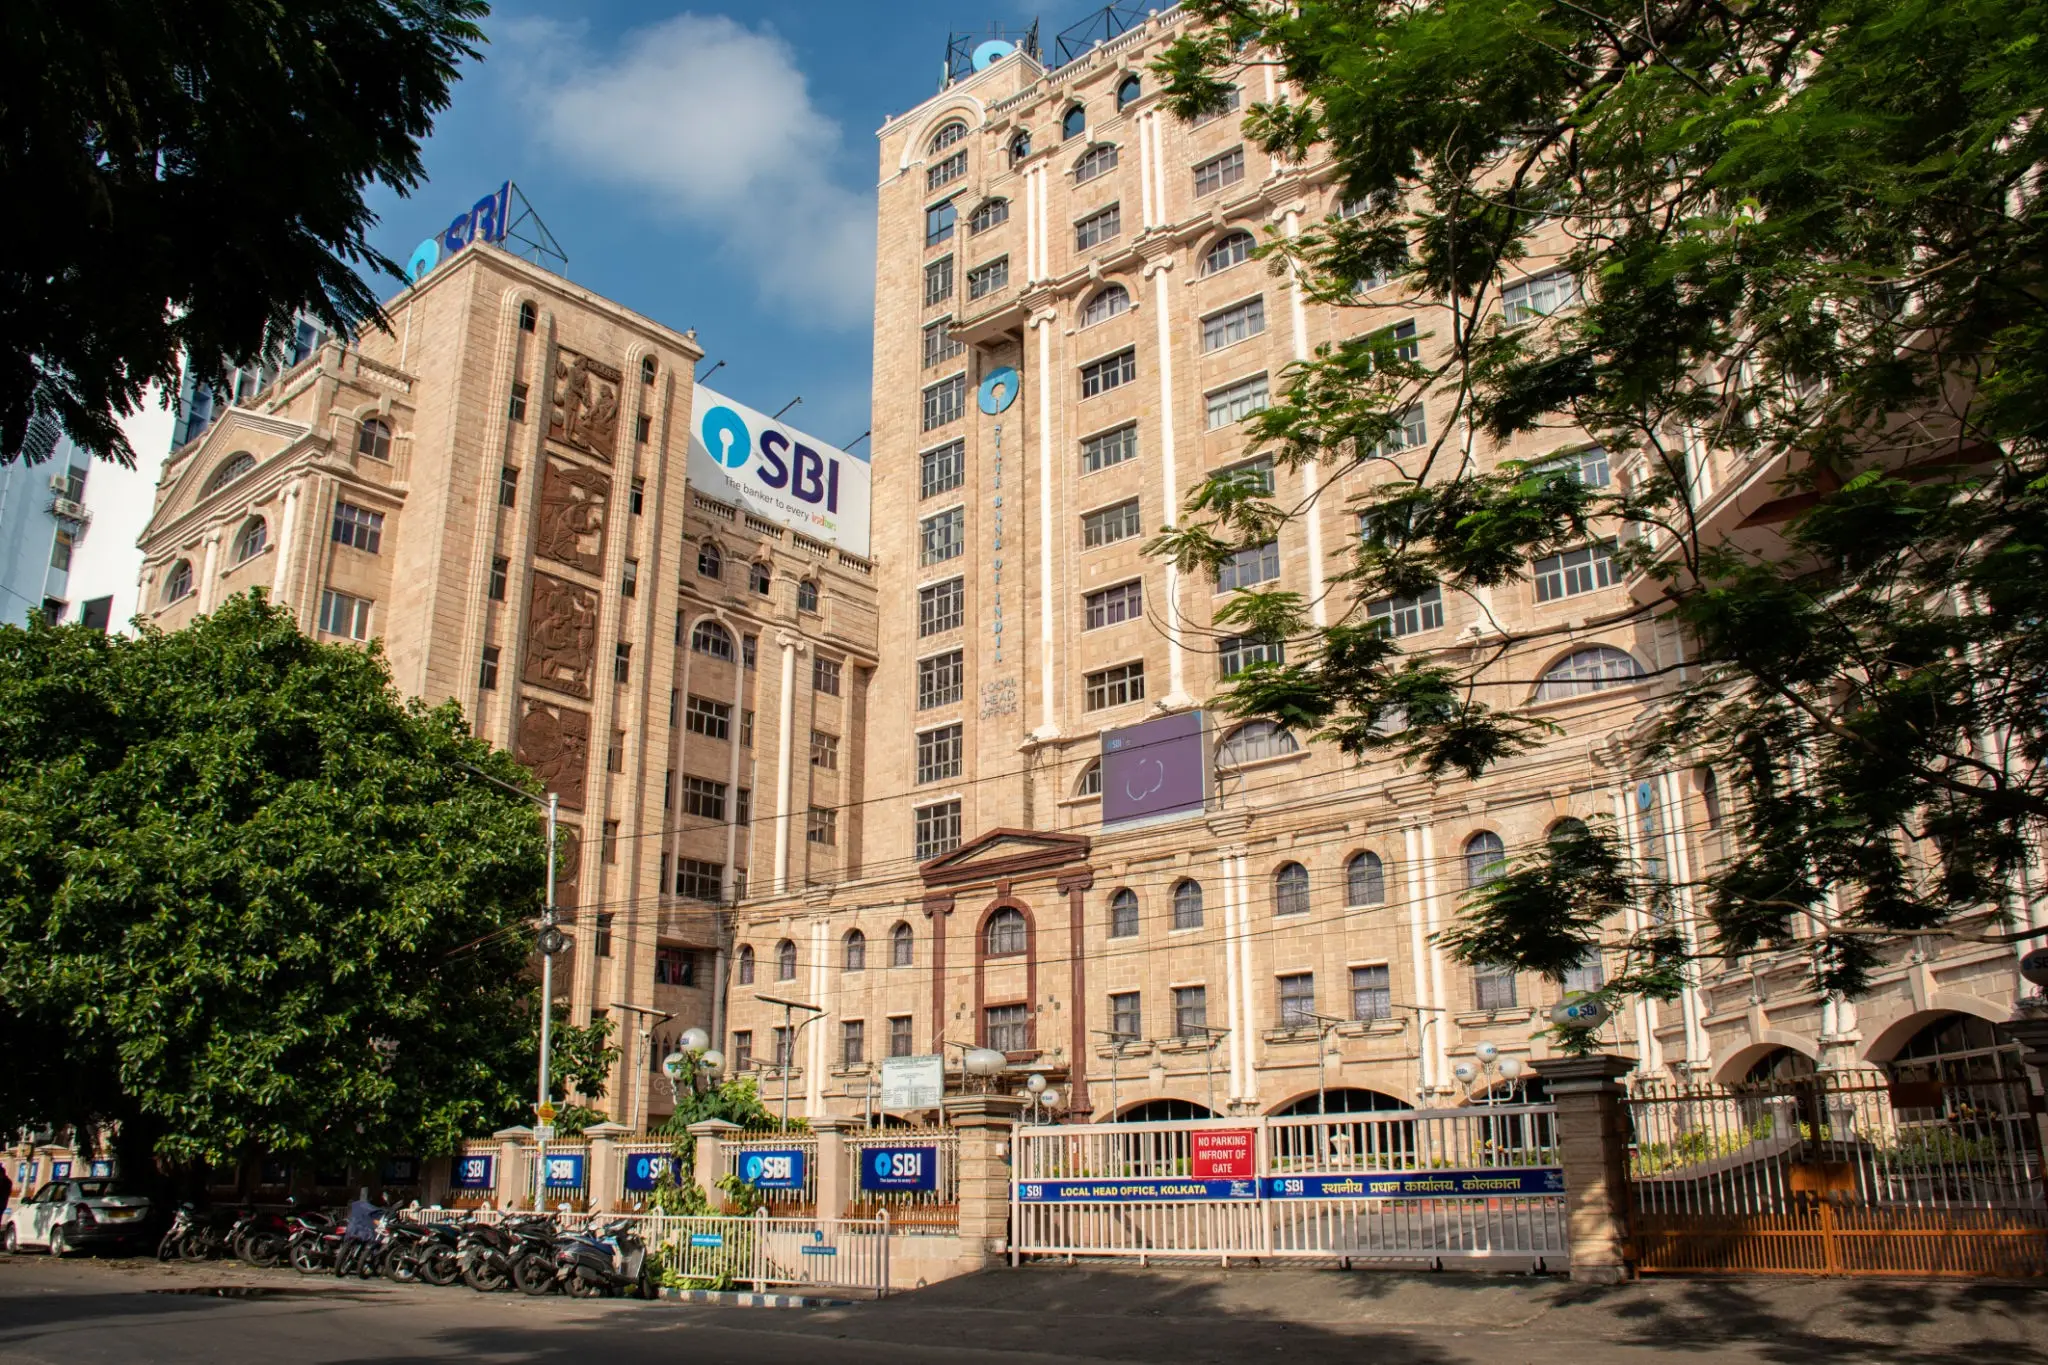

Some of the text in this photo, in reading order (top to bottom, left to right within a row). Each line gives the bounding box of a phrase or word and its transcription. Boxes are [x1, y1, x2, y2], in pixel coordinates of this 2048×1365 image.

[446, 180, 512, 252] SBI
[757, 430, 840, 514] SBI
[724, 476, 741, 490] The
[743, 484, 773, 503] banker
[775, 500, 784, 509] to
[786, 505, 810, 521] every
[984, 690, 1016, 707] HEAD
[1580, 1004, 1597, 1017] SBI
[1198, 1135, 1247, 1147] NO PARKING
[1199, 1149, 1247, 1160] INFRONT OF
[468, 1160, 485, 1178] SBI
[551, 1159, 574, 1179] SBI
[763, 1156, 792, 1179] SBI
[892, 1153, 922, 1177] SBI
[1212, 1163, 1232, 1173] GATE
[1027, 1185, 1042, 1197] SBI
[1061, 1185, 1207, 1197] LOCAL HEAD OFFICE, KOLKATA
[1285, 1179, 1304, 1193] SBI
[1321, 1175, 1521, 1194] स्थानीय प्रधान कार्यालय, कोलकाता
